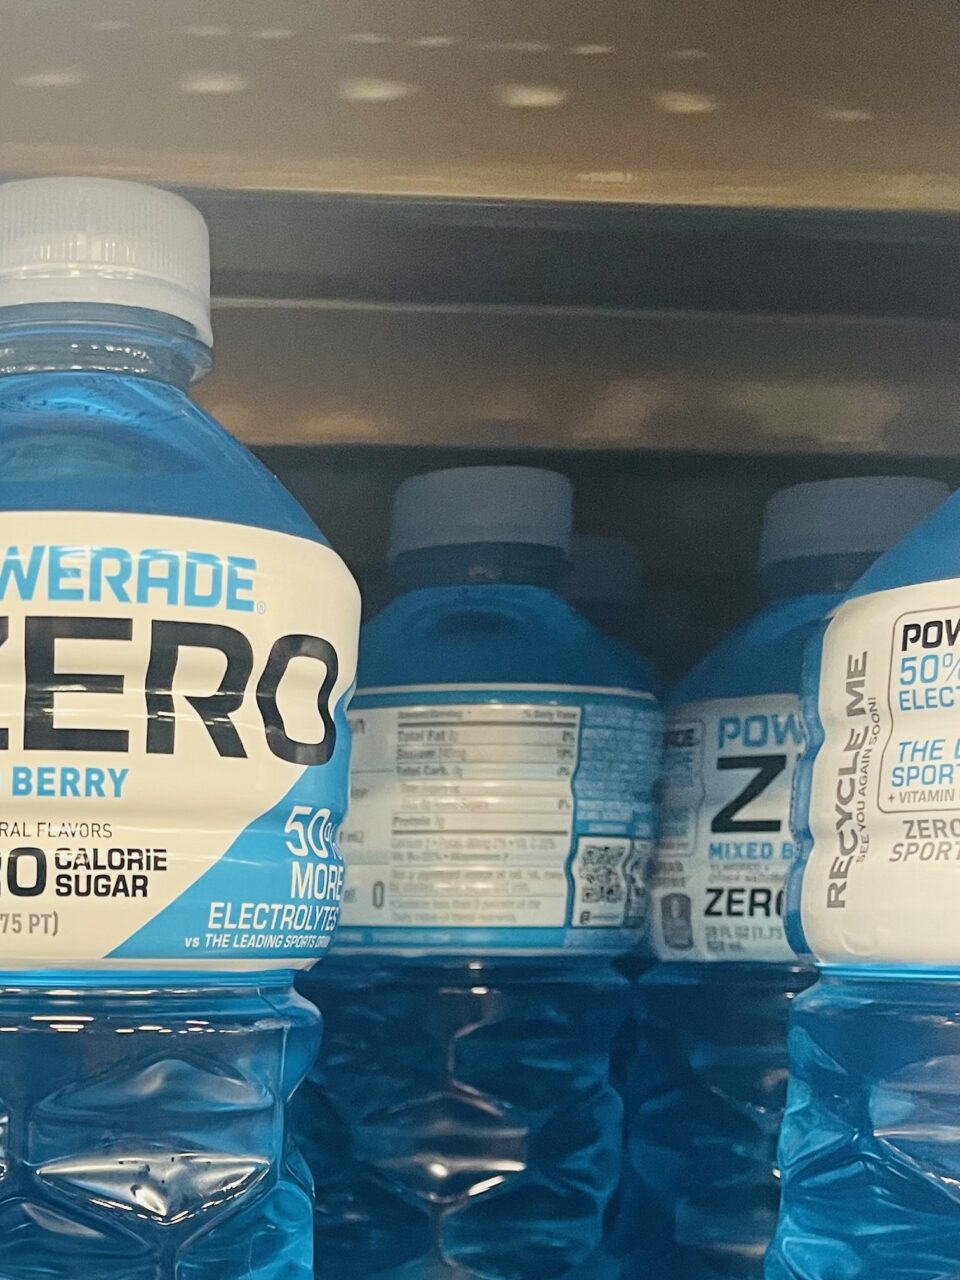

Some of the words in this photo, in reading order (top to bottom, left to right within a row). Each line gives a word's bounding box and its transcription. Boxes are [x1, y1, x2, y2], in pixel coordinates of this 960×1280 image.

[899, 653, 960, 686] 50%
[846, 651, 868, 717] ME
[898, 739, 946, 763] THE
[11, 767, 130, 798] BERRY
[859, 749, 872, 797] AGAIN
[891, 763, 960, 788] SPOR
[899, 789, 956, 804] VITAMIN
[826, 725, 869, 909] RECYCLE
[856, 801, 866, 832] YOU
[36, 822, 113, 839] FLAVORS
[55, 848, 167, 872] CALORIE
[709, 842, 773, 860] MIXED
[55, 874, 148, 898] SUGAR
[291, 861, 344, 901] MORE
[29, 910, 60, 937] PT)
[205, 934, 231, 948] THE
[233, 935, 283, 948] LEADING
[284, 935, 316, 949] SPORTS
